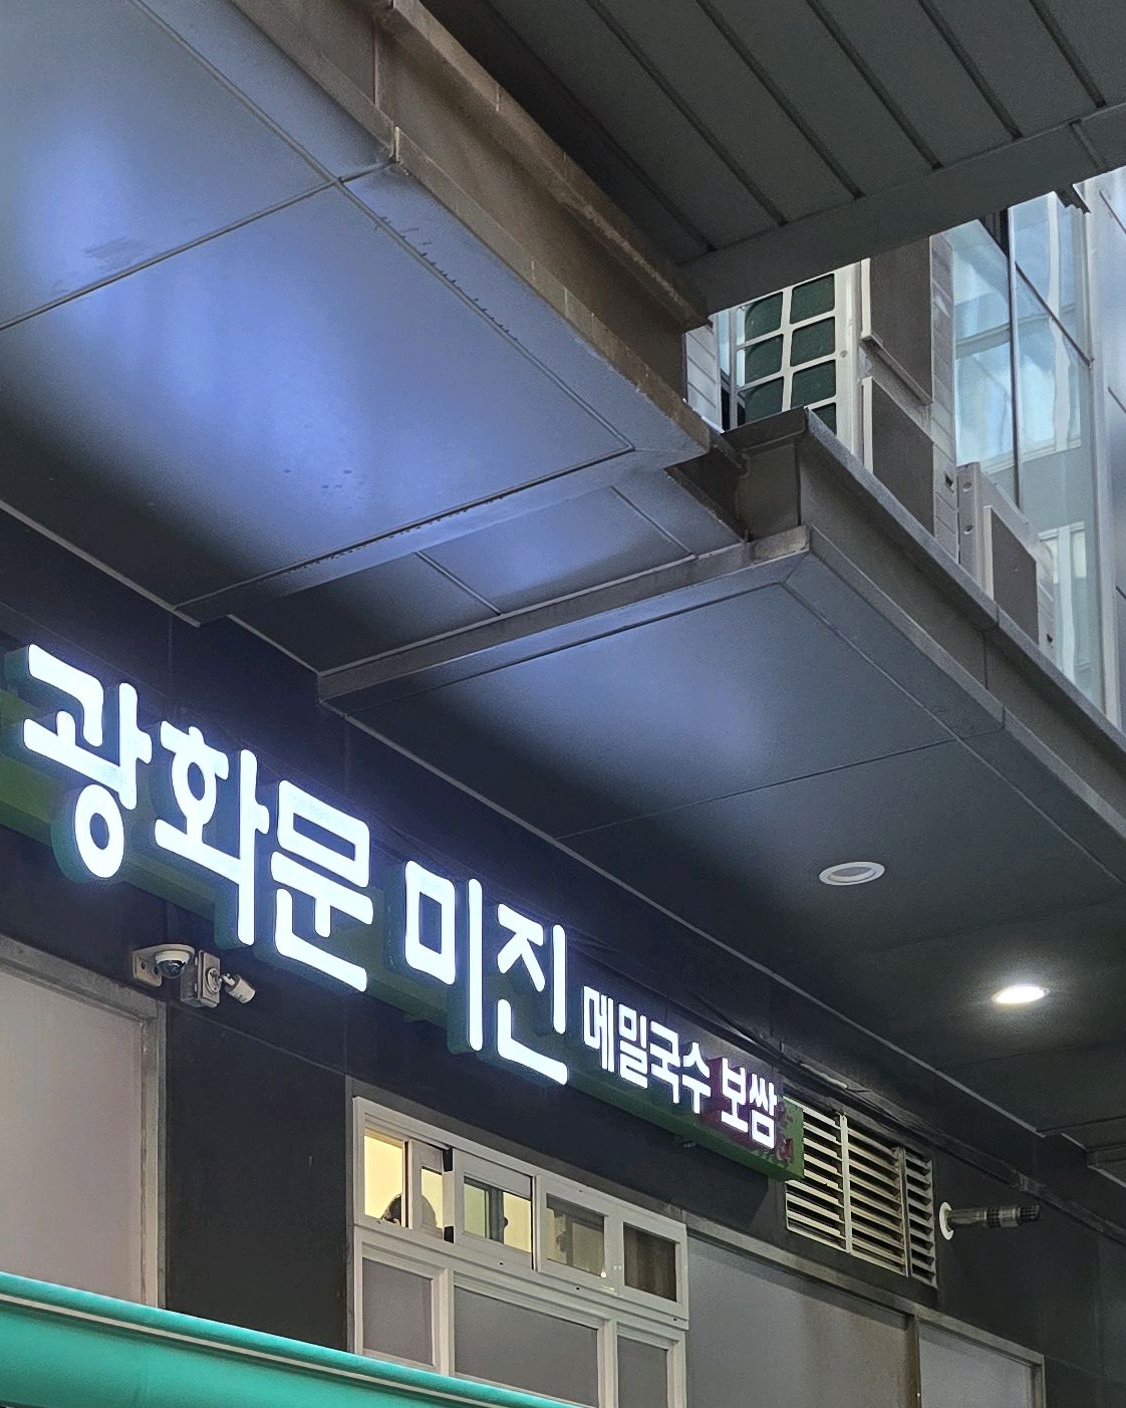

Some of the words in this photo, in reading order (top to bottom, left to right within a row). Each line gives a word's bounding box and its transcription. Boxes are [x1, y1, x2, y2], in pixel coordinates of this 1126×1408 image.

[23, 643, 374, 992] 광화문
[403, 860, 568, 1085] 미진
[583, 985, 711, 1114] 메밀국수
[721, 1057, 777, 1149] 보쌈
